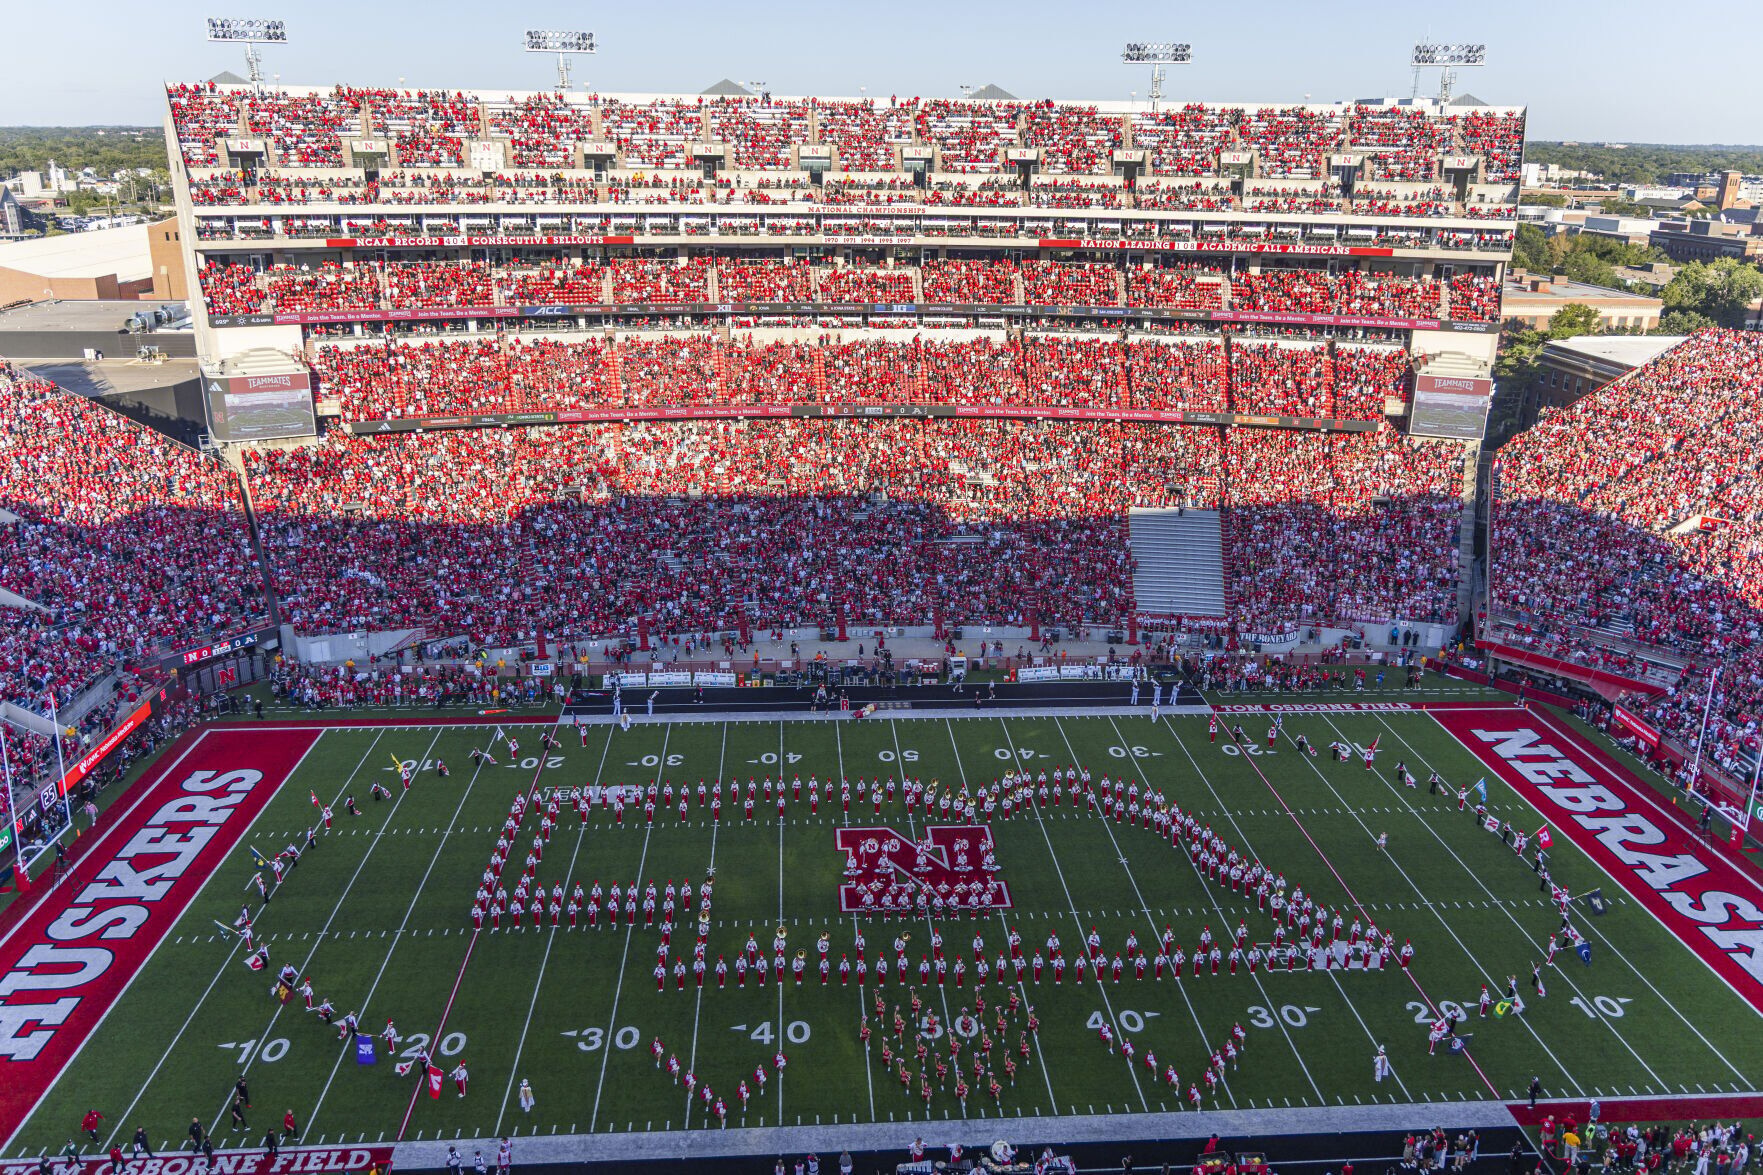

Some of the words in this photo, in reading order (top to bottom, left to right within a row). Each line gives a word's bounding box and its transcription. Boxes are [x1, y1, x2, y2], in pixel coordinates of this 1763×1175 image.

[240, 141, 250, 150] N
[364, 142, 374, 150] N
[482, 143, 491, 151] N
[811, 147, 819, 155] N
[1019, 150, 1027, 158] N
[1124, 152, 1133, 160] N
[1232, 154, 1241, 162] N
[1343, 156, 1352, 164] N
[1456, 158, 1466, 167] N
[356, 238, 389, 246] NCAA
[394, 237, 439, 246] RECORD
[445, 237, 467, 245] 404
[472, 236, 548, 245] CONSECUTIVE
[553, 235, 604, 244] SELLOUTS
[1080, 240, 1120, 248] NATION
[1125, 241, 1170, 249] LEADING
[1176, 242, 1195, 250] 108
[1202, 243, 1258, 252] ACADEMIC
[1263, 244, 1282, 252] ALL
[1287, 246, 1350, 255] AMERICANS
[535, 306, 562, 314] ACC
[248, 376, 290, 389] TEAMMATES
[1434, 378, 1474, 391] TEAMMATES
[827, 407, 835, 415] N
[235, 639, 241, 647] 0
[188, 652, 197, 662] N
[202, 649, 208, 657] 0
[218, 667, 236, 685] N
[841, 699, 849, 711] R
[1270, 703, 1353, 711] OSBORNE
[1358, 702, 1411, 711] FIELD
[87, 750, 100, 768] UNMC
[100, 735, 118, 754] Nebraska
[117, 720, 135, 739] Medicine
[1221, 743, 1265, 756] 20
[760, 752, 803, 763] 40
[878, 750, 919, 762] 50
[995, 748, 1035, 760] 40
[1108, 746, 1150, 758] 30
[520, 756, 566, 769] 20
[641, 754, 685, 766] 30
[43, 787, 55, 806] 25
[1486, 818, 1499, 831] N
[1539, 830, 1550, 844] R
[867, 843, 877, 851] N
[890, 843, 898, 851] N
[924, 842, 931, 850] N
[834, 825, 1015, 912] N
[0, 769, 264, 1062] HUSKERS
[1405, 1000, 1468, 1024] 20
[1570, 995, 1624, 1018] 10
[1086, 1009, 1145, 1032] 40
[1247, 1004, 1307, 1028] 30
[751, 1020, 811, 1045] 40
[920, 1016, 978, 1039] 50
[401, 1032, 467, 1058] 20
[578, 1026, 640, 1052] 30
[237, 1038, 290, 1063] 10
[270, 1150, 371, 1172] FIELD
